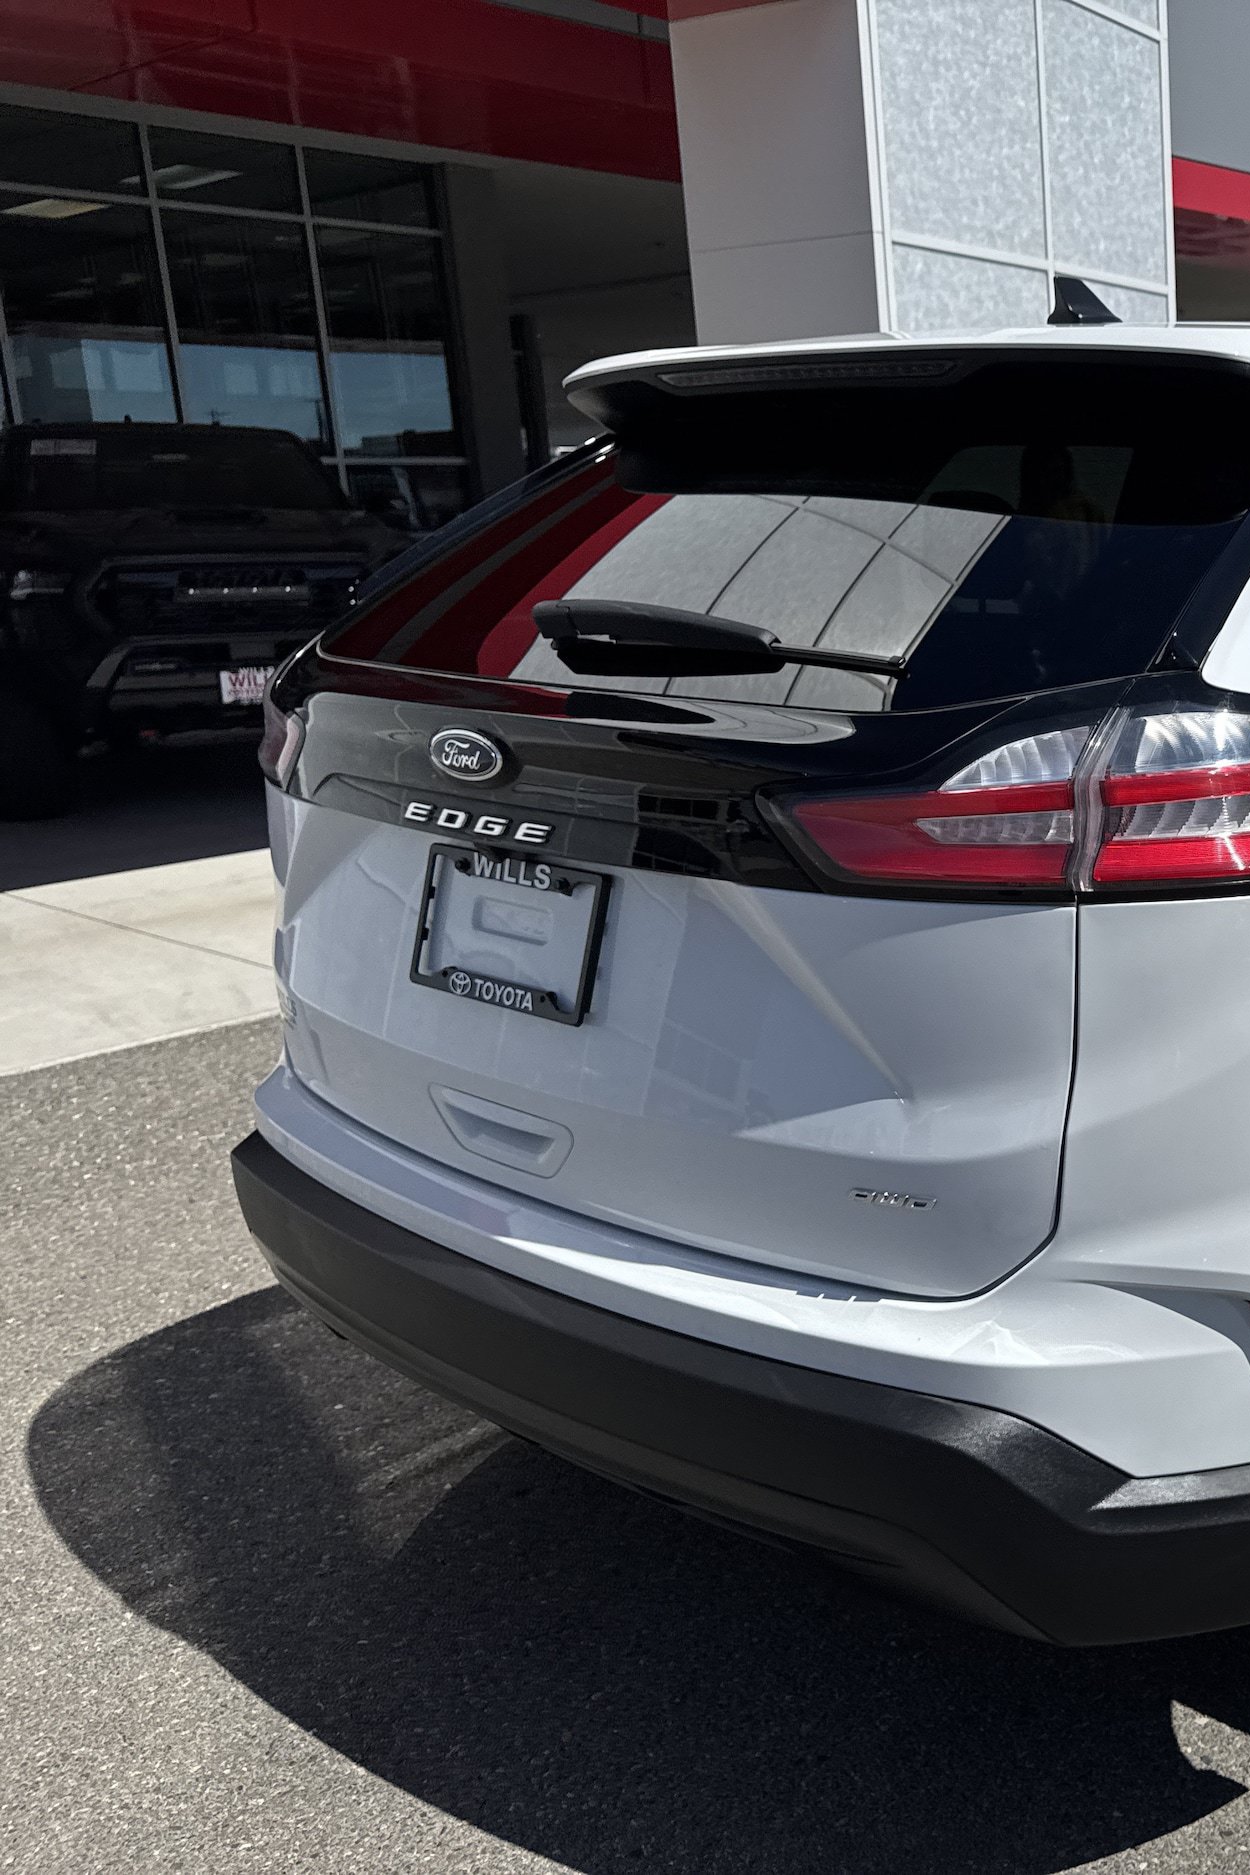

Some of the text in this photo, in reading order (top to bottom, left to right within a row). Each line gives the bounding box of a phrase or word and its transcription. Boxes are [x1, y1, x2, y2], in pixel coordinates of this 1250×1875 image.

[441, 739, 481, 770] Ford
[404, 801, 553, 844] EDGE
[473, 851, 553, 891] WILLS
[474, 978, 534, 1012] TOYOTA
